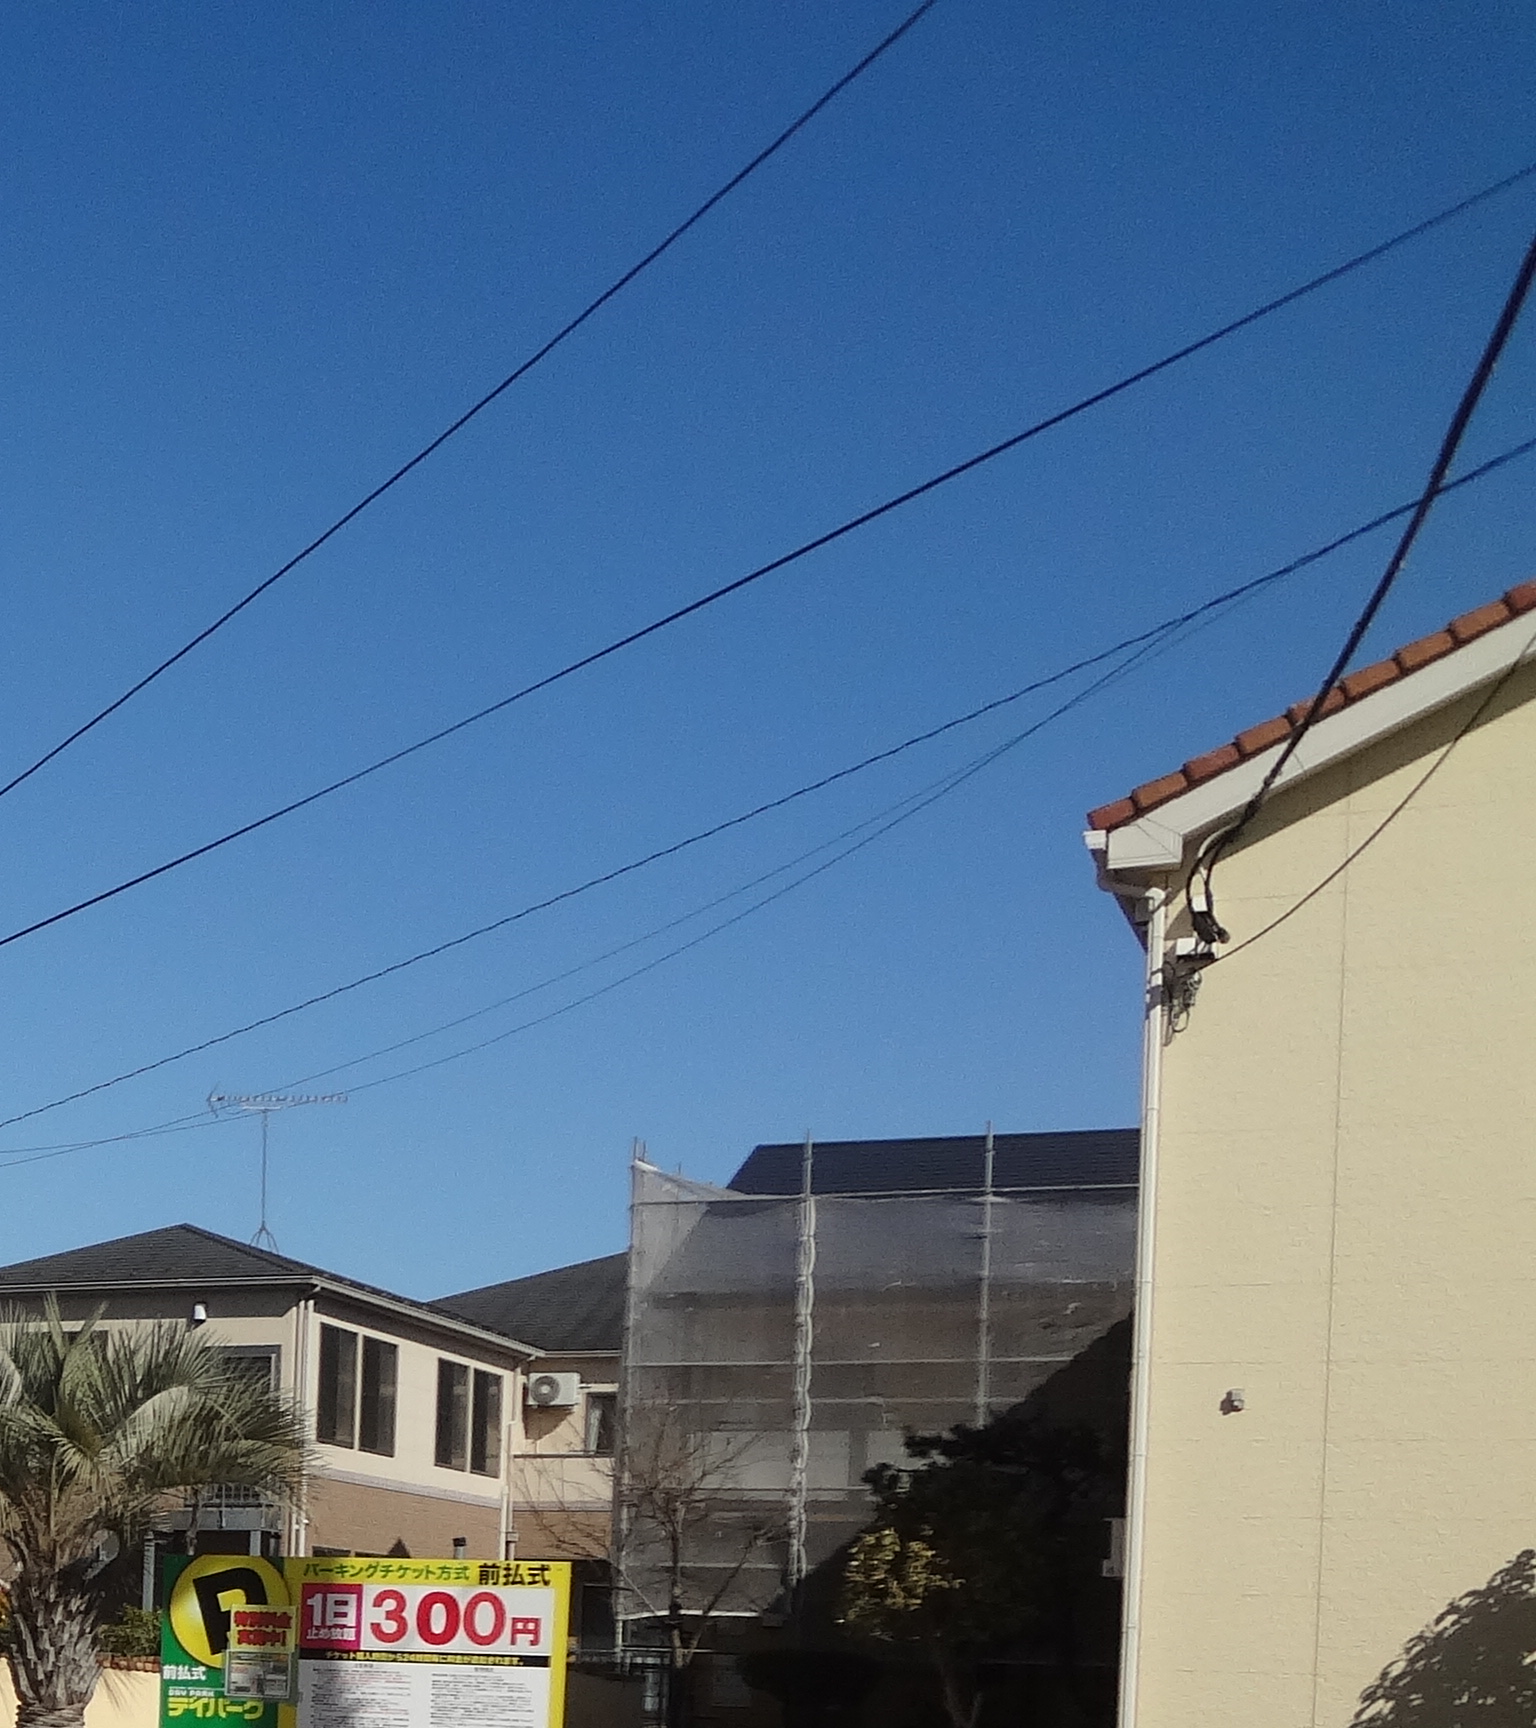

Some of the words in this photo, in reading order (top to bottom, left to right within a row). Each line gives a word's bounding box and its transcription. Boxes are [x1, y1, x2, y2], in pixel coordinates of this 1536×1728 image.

[303, 1562, 470, 1581] パーキングチケット方式
[478, 1564, 551, 1586] 前払式
[306, 1593, 358, 1628] 1日
[370, 1588, 542, 1647] 300円
[163, 1664, 207, 1680] 前払式
[168, 1697, 265, 1720] デイパーク
